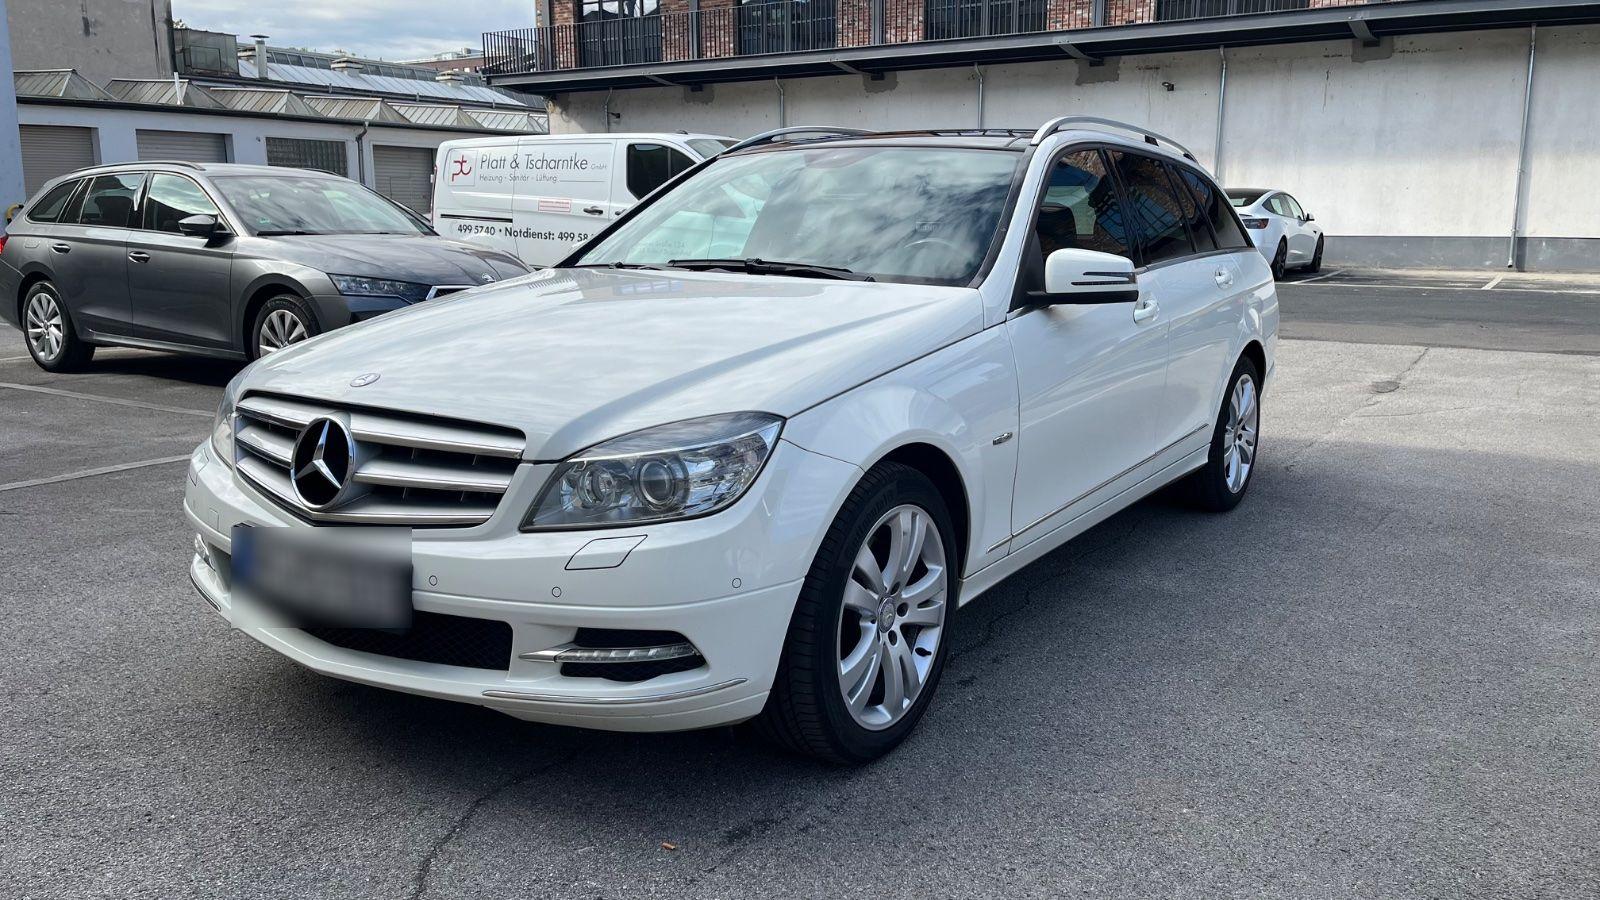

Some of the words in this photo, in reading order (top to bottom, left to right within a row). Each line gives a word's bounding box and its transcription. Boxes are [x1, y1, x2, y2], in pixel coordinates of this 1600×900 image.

[480, 153, 507, 170] Platt
[510, 153, 520, 170] &
[525, 152, 588, 170] Tscharntke
[480, 174, 503, 184] Heizung
[536, 173, 558, 184] Lüftung
[457, 224, 472, 234] 499
[474, 225, 496, 236] 5740
[504, 227, 555, 241] Notdienst:
[557, 231, 575, 242] 499
